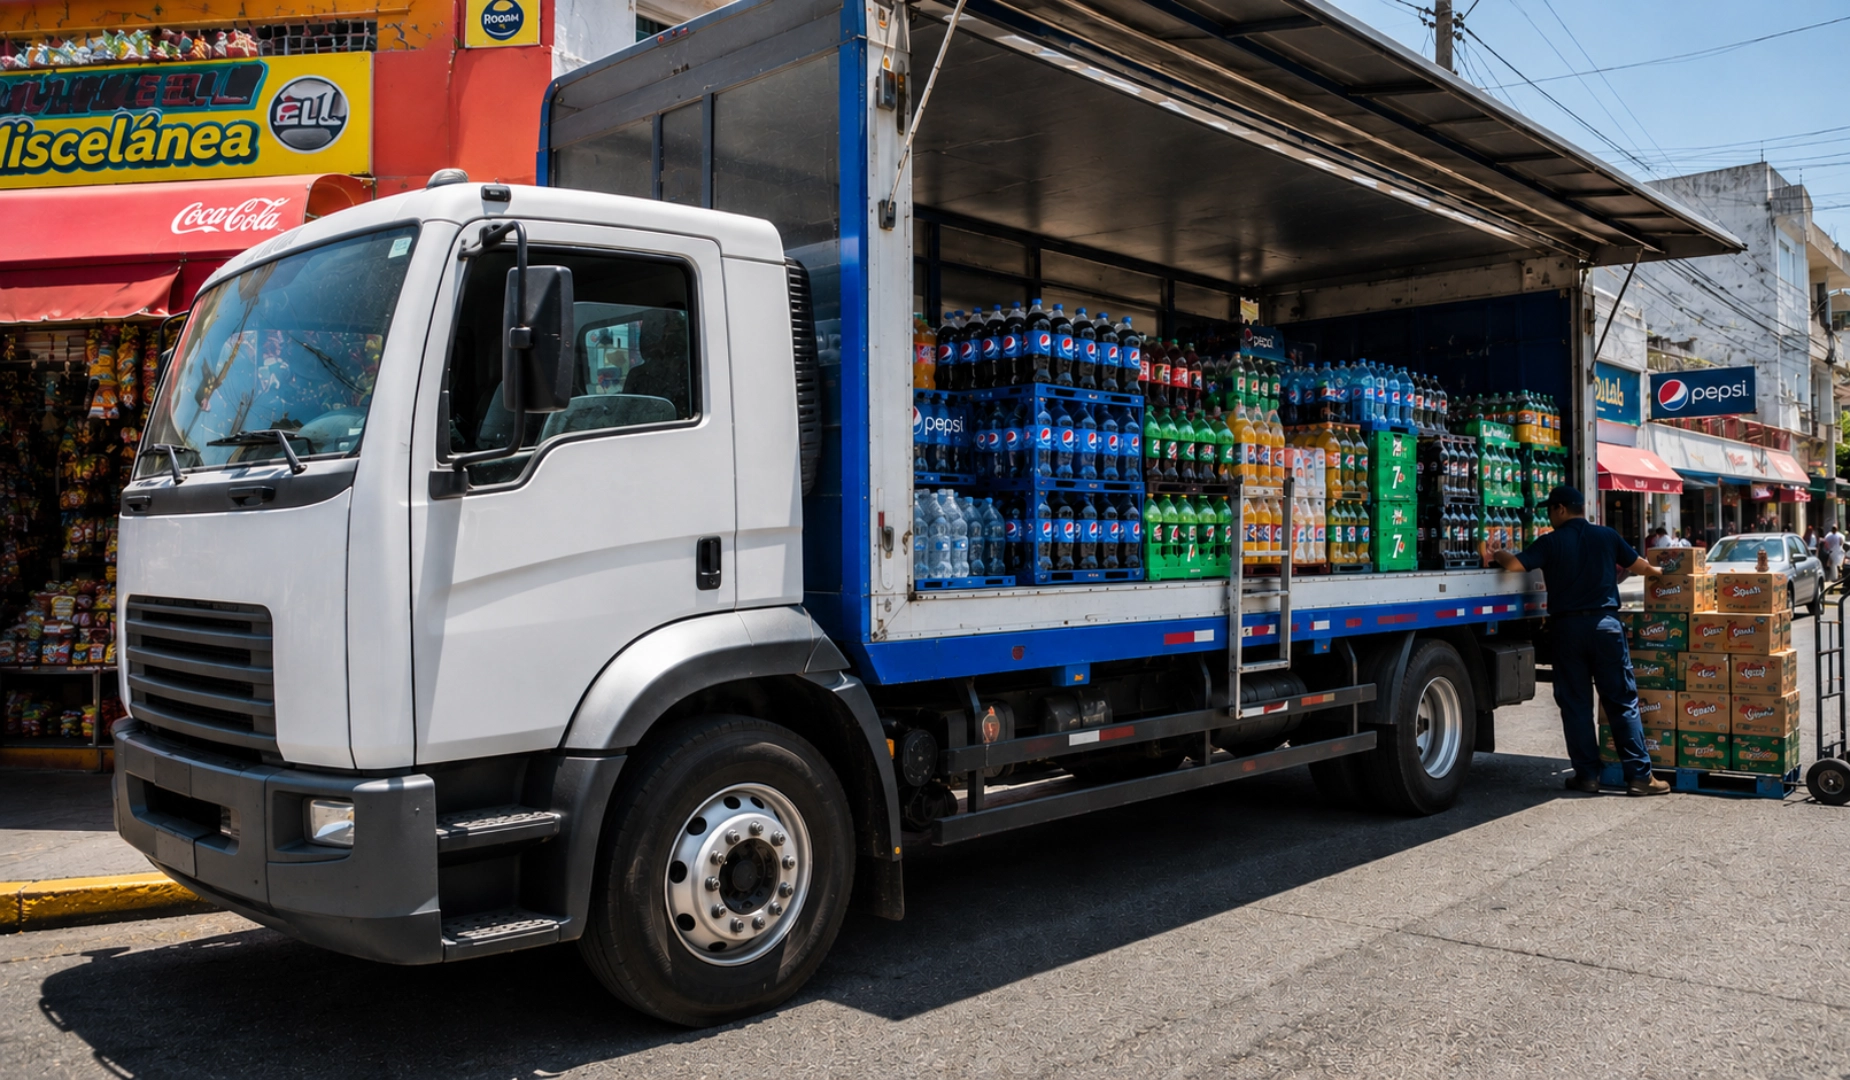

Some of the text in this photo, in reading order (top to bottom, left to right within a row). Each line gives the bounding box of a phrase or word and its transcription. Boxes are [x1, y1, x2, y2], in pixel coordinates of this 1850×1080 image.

[171, 197, 291, 235] Coca-Cola
[1691, 379, 1748, 404] pepsi
[924, 416, 964, 436] pepsi
